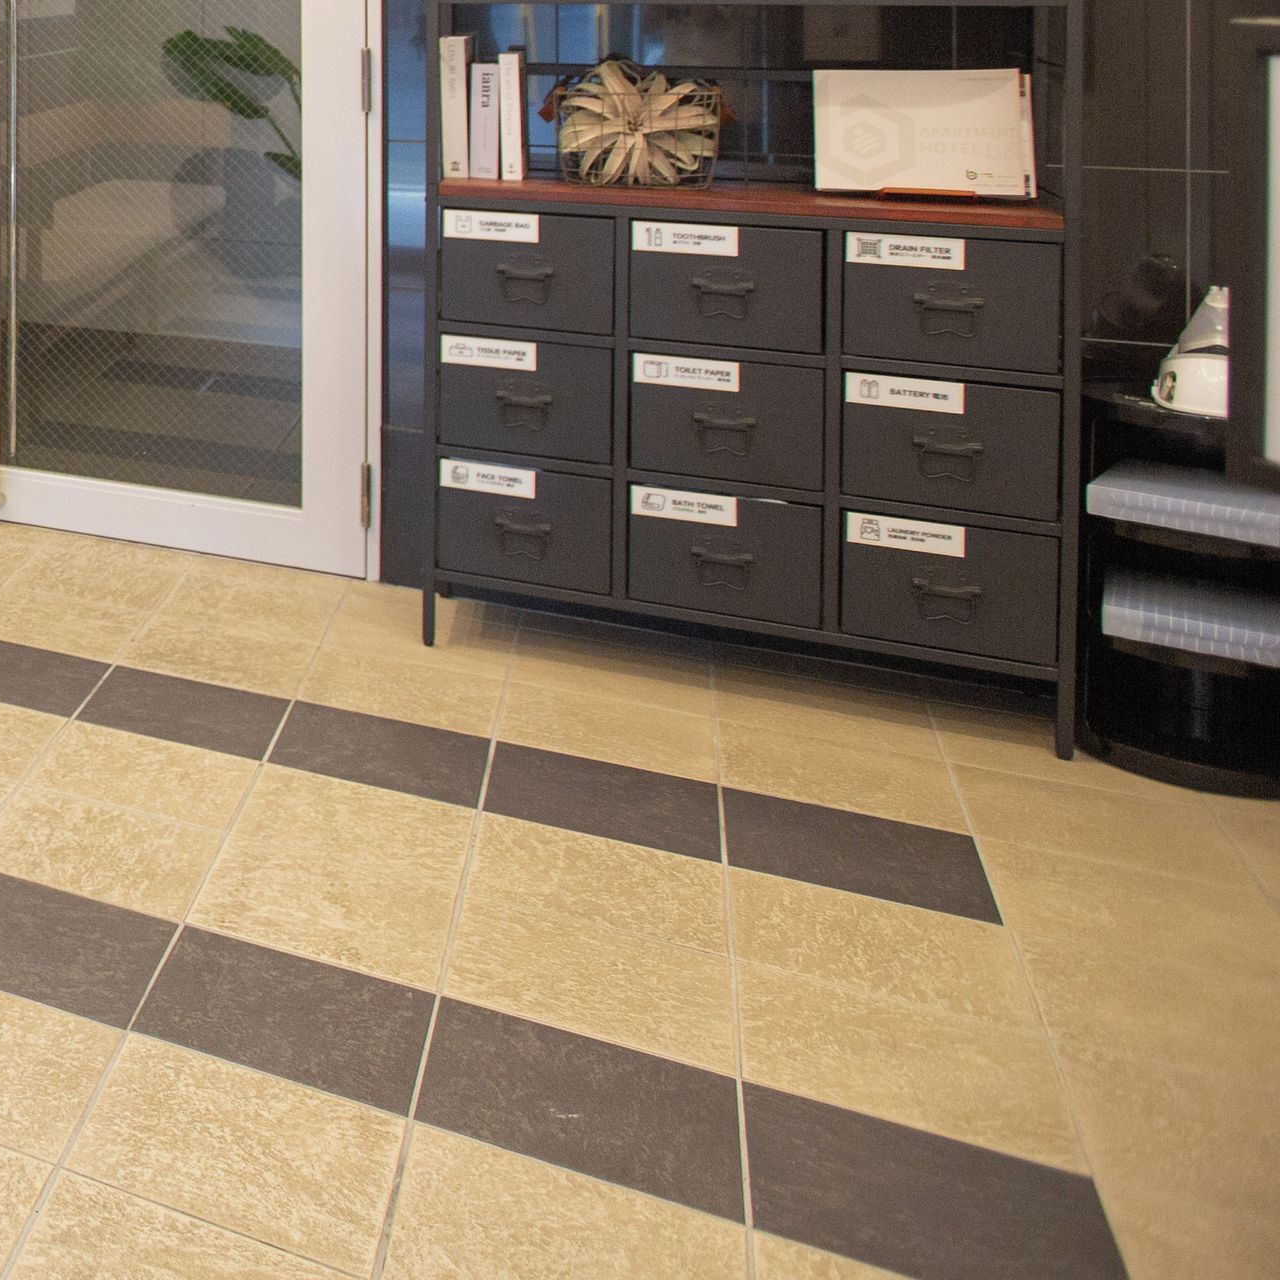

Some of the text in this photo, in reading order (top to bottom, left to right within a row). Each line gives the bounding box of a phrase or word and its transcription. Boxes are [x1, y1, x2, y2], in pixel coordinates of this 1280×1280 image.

[888, 244, 952, 255] DRAIN FILTER
[502, 349, 527, 357] PAPER
[674, 366, 703, 374] TOILET
[703, 368, 731, 377] PAPER
[889, 388, 930, 398] BATTERY
[672, 499, 725, 512] BATH TOWEL
